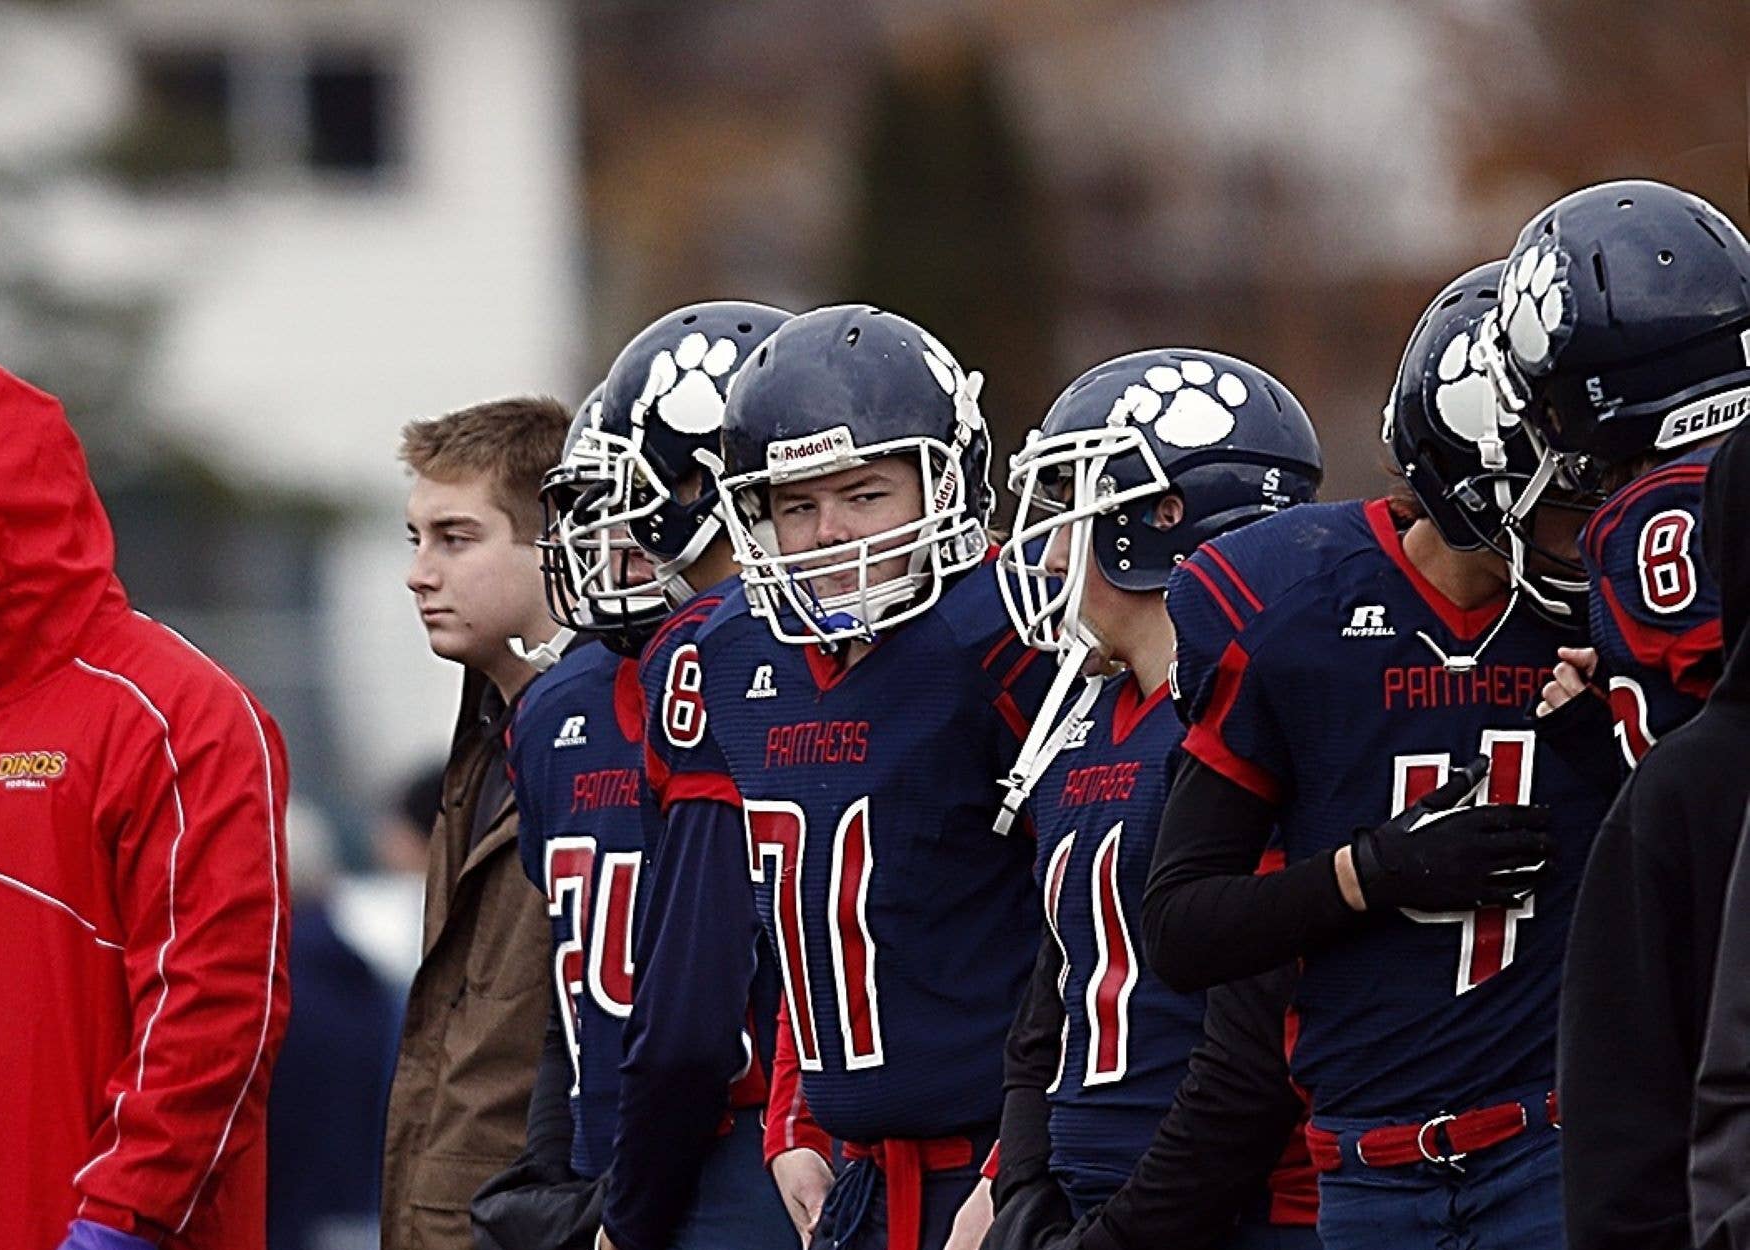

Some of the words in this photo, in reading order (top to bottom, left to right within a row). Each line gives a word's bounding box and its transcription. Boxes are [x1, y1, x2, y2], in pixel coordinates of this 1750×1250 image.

[784, 437, 834, 460] Riddell
[1672, 396, 1750, 437] schut
[1637, 509, 1697, 614] 8
[662, 643, 707, 748] 8
[764, 720, 871, 769] PANTHERS
[743, 796, 885, 1072] 71
